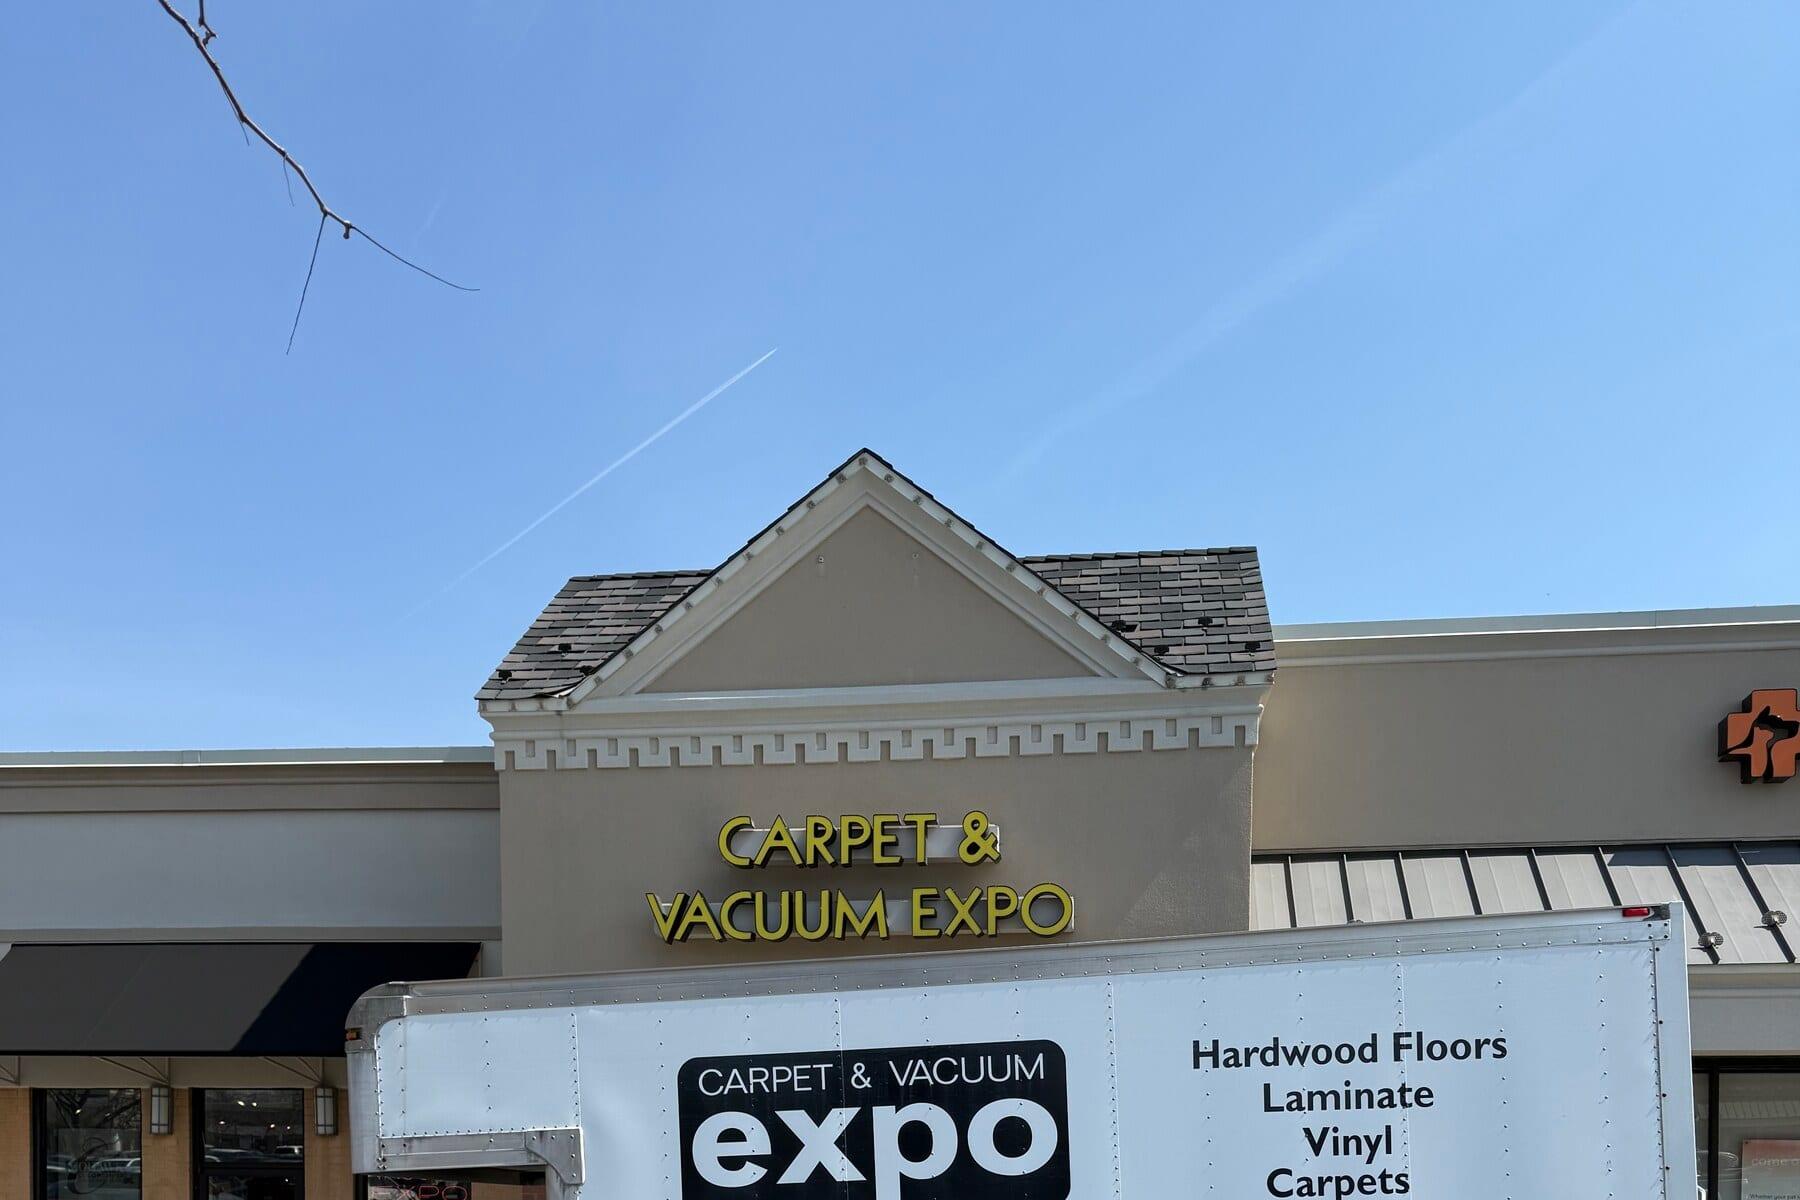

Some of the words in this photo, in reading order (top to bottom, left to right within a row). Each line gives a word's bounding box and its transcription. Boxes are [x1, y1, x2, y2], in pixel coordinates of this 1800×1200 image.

[717, 812, 935, 866] CARPET
[958, 811, 1000, 865] &
[646, 888, 888, 942] VACUUM
[911, 883, 1073, 938] EXPO
[1192, 1032, 1378, 1070] Hardwood
[1393, 1031, 1508, 1062] Floors
[698, 1063, 834, 1096] CARPET
[850, 1062, 873, 1089] &
[888, 1052, 1044, 1087] VACUUM
[1263, 1082, 1434, 1113] Laminate
[1303, 1124, 1393, 1164] Vinyl
